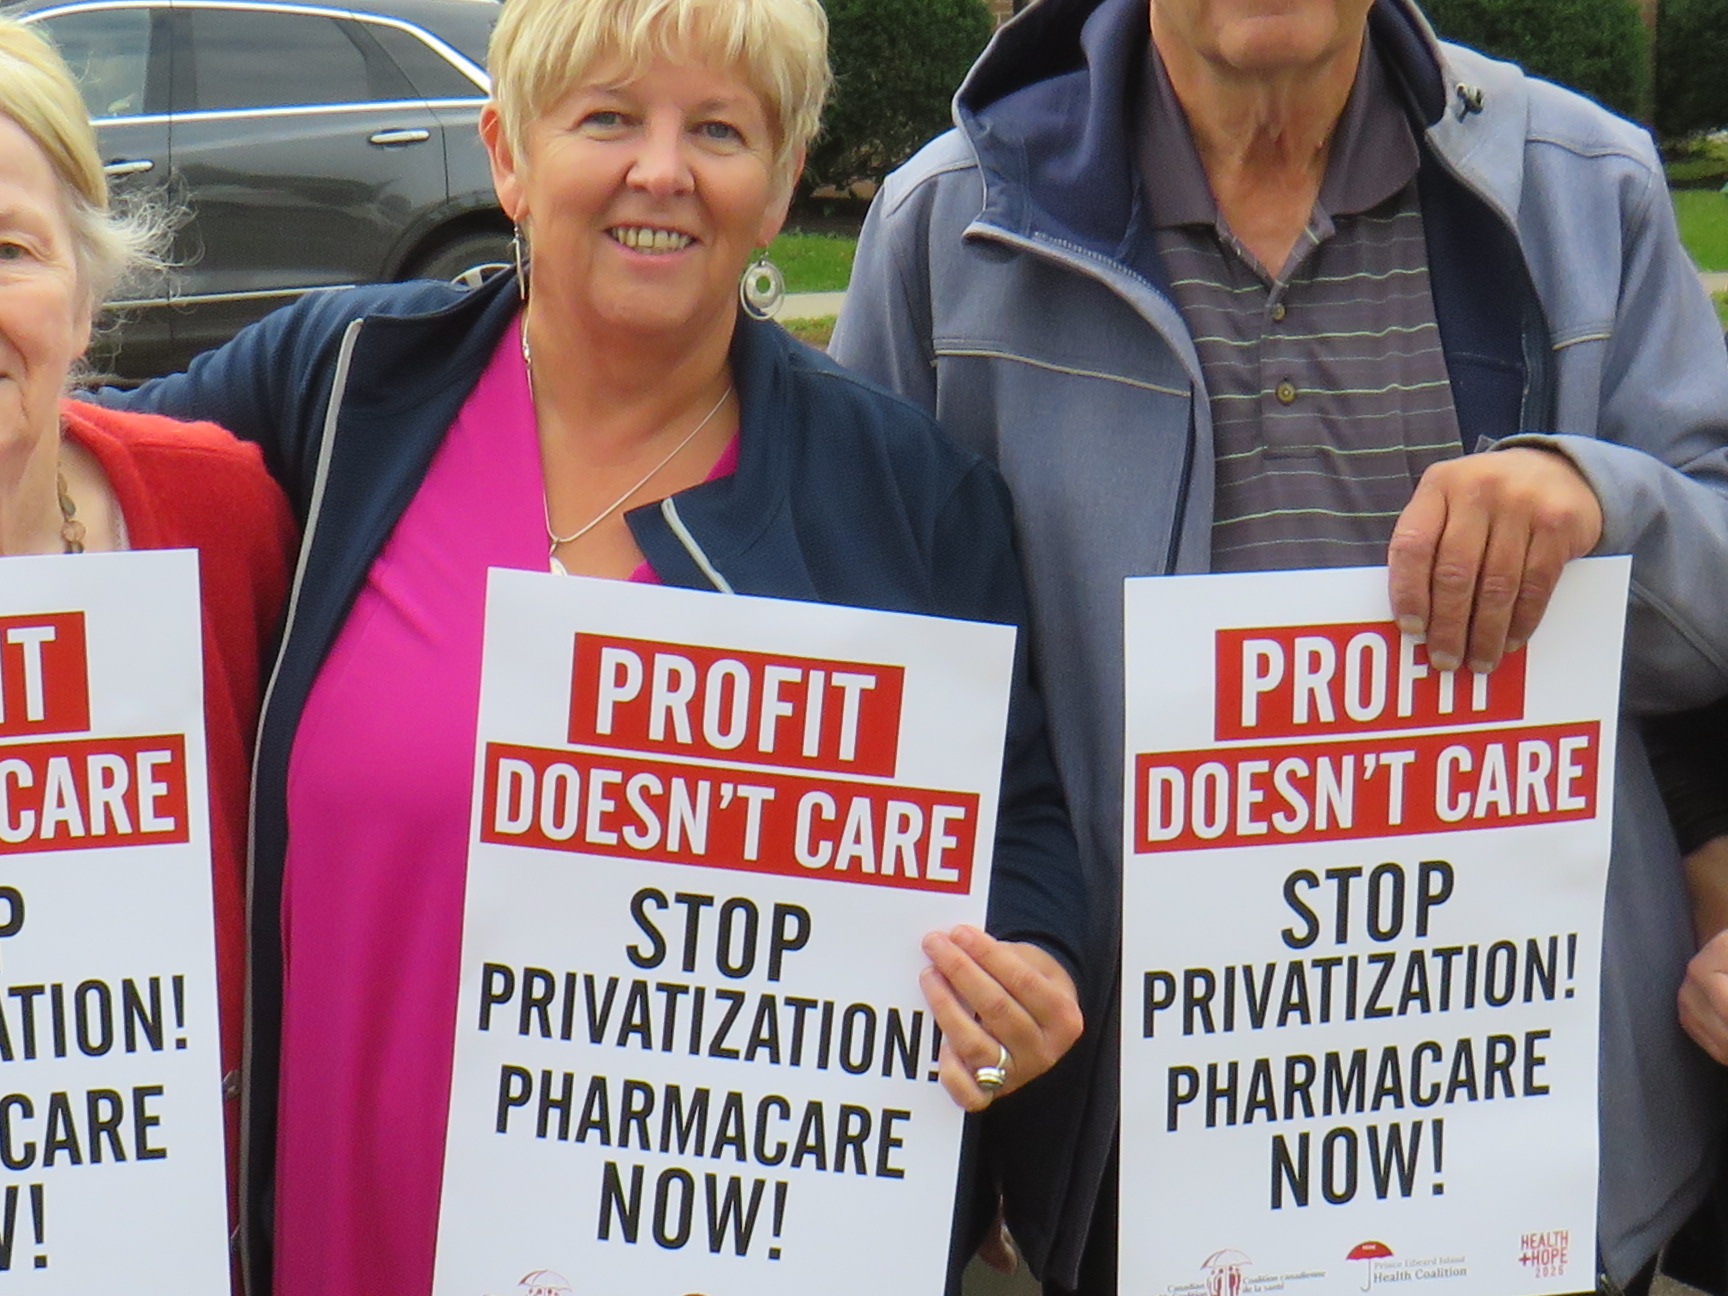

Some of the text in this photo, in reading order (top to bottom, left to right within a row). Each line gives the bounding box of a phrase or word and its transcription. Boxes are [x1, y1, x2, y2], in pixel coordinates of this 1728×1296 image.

[595, 646, 877, 761] PROFIT
[494, 757, 968, 883] DOESN'T CARE
[1147, 735, 1588, 843] DOESN'T CARE
[625, 886, 812, 983] STOP
[1281, 859, 1454, 949] STOP
[478, 961, 944, 1083] PRIVATIZATION!
[1142, 933, 1579, 1039] PRIVATIZATION!
[494, 1064, 912, 1181] PHARMACARE
[1166, 1028, 1551, 1132] PHARMACARE
[597, 1160, 790, 1262] NOW!
[1270, 1118, 1445, 1211] NOW!
[1373, 1266, 1467, 1283] Health Coalition
[1521, 1230, 1569, 1251] HEALTH
